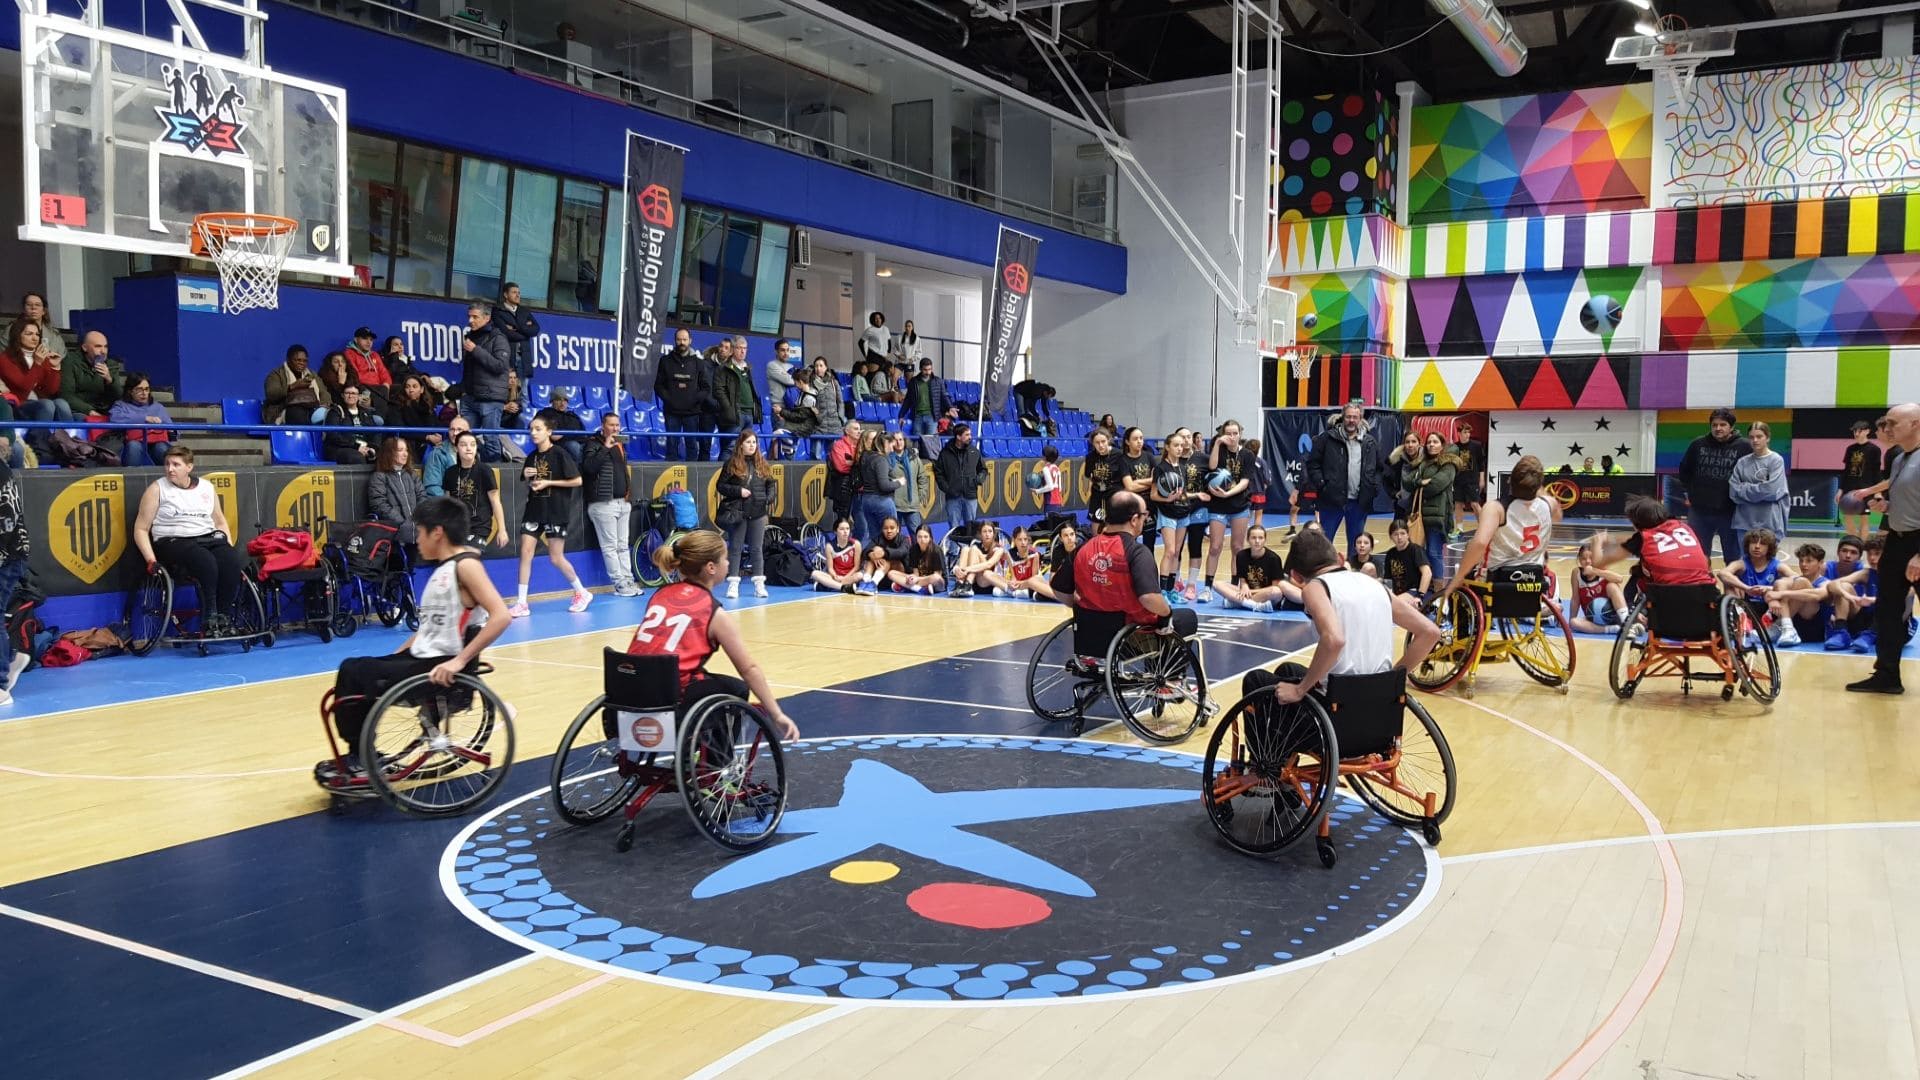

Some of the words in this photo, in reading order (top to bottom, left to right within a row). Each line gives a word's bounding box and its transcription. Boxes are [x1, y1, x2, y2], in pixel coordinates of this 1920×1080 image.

[53, 199, 65, 219] 1
[94, 480, 118, 492] FEB
[311, 475, 330, 486] FEB
[806, 478, 822, 516] 100
[1581, 491, 1610, 499] MUJER
[64, 497, 112, 564] 100
[1520, 525, 1540, 554] 5
[1652, 527, 1697, 554] 26
[637, 604, 692, 652] 21
